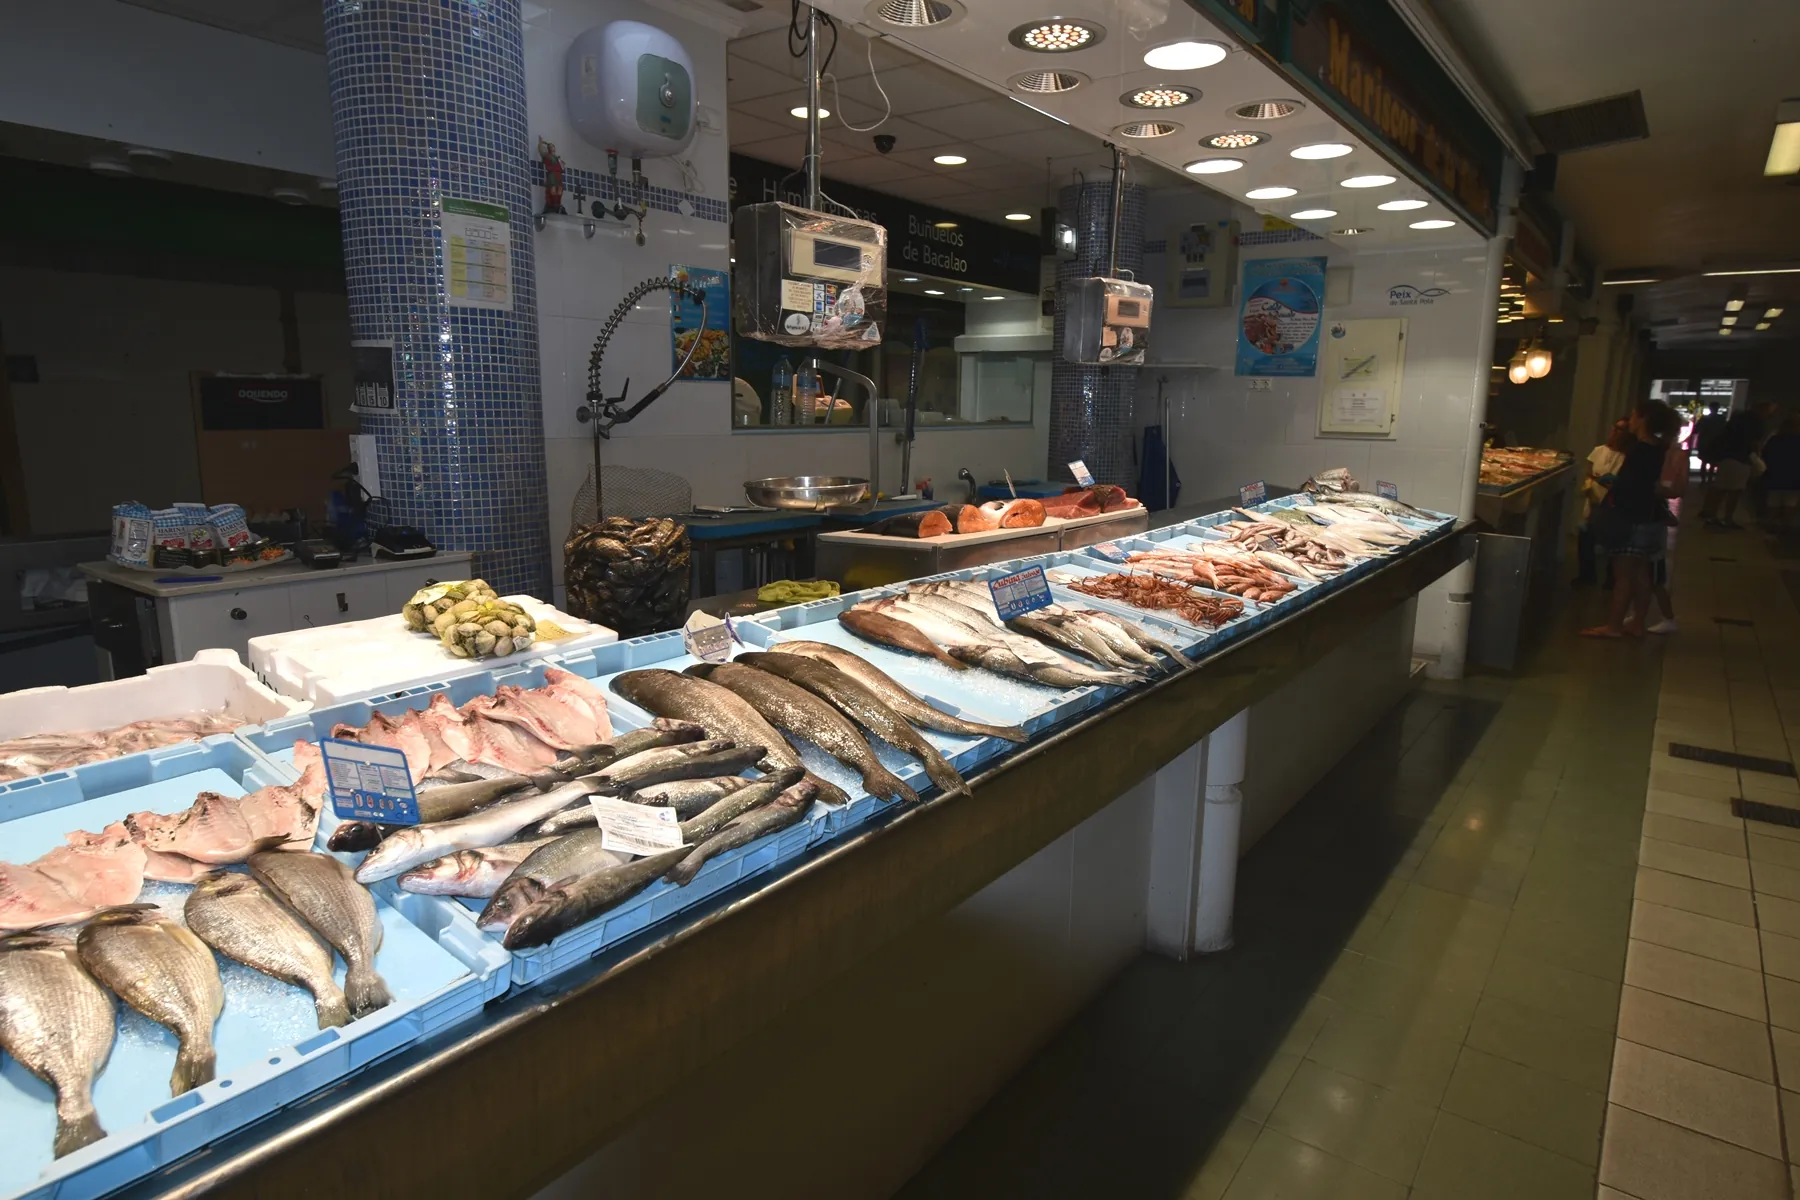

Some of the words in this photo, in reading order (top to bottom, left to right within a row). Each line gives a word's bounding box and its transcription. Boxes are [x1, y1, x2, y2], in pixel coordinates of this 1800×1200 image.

[908, 213, 965, 248] Buñuelos
[902, 239, 919, 262] de
[922, 243, 968, 273] Bacalao
[1389, 290, 1412, 299] Peix
[1399, 298, 1418, 306] Santa
[379, 396, 388, 406] 10
[220, 520, 245, 533] HARINA
